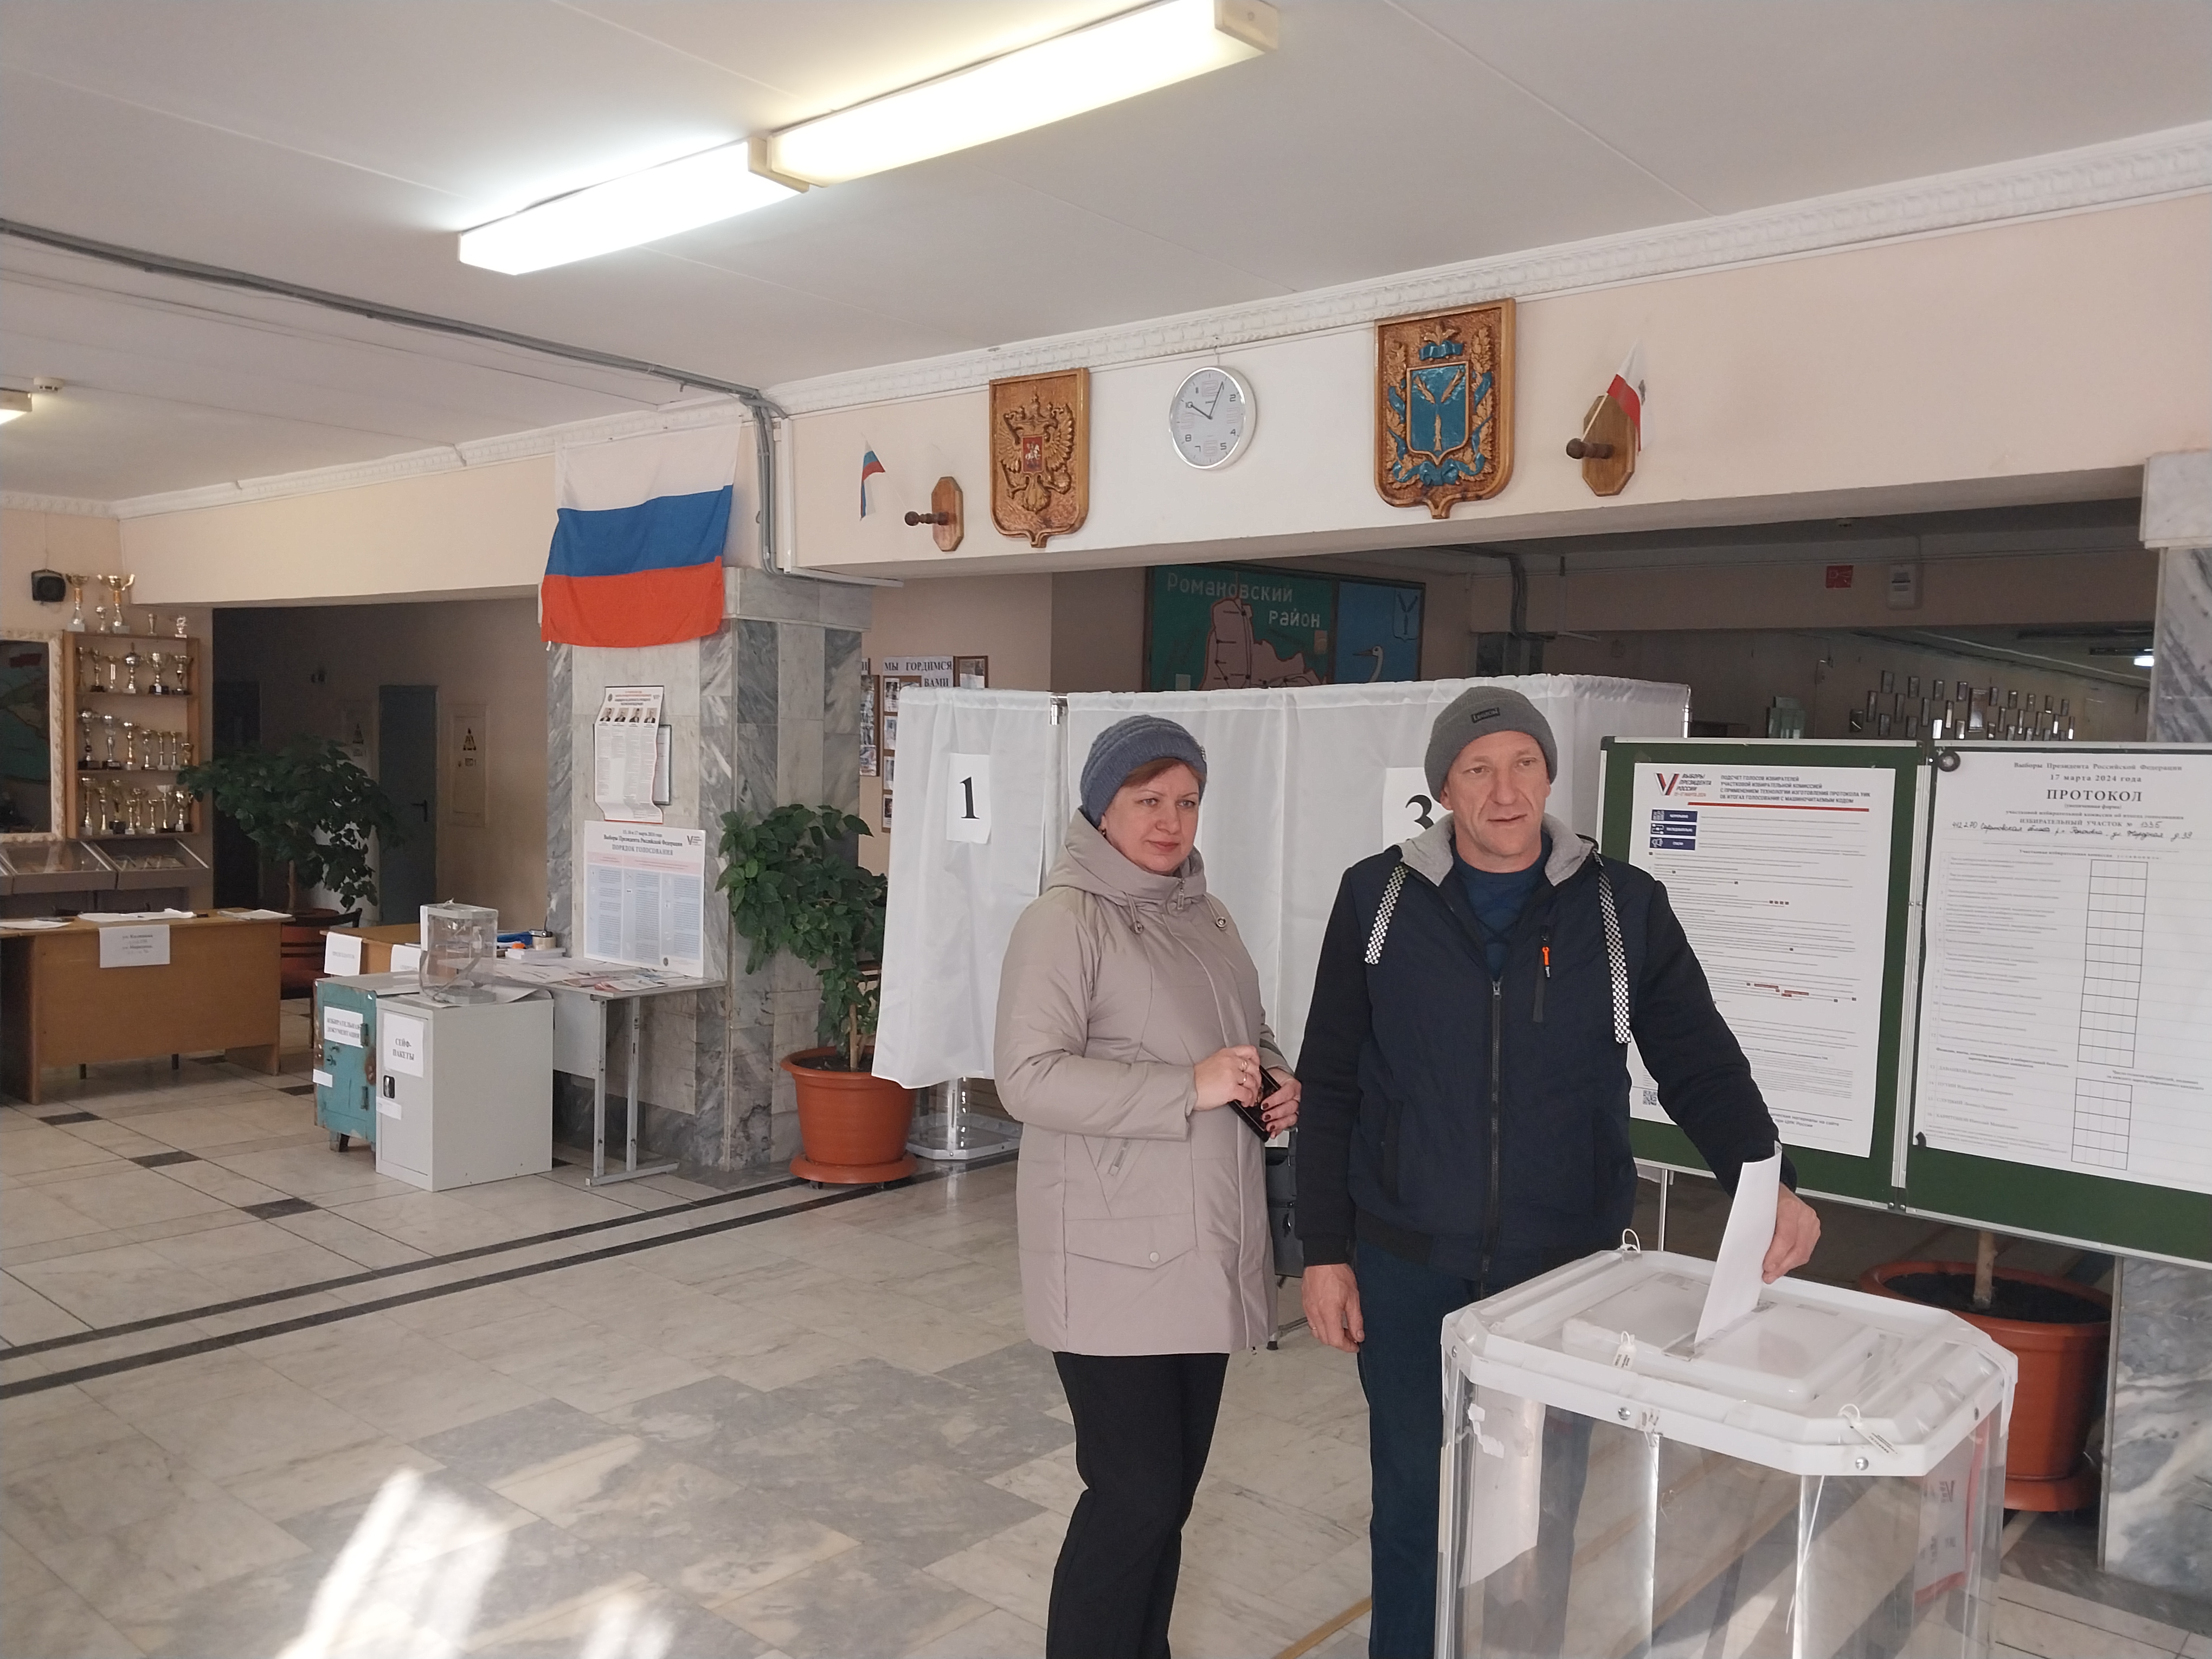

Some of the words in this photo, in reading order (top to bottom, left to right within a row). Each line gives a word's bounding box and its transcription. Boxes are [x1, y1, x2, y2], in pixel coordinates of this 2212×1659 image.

[1167, 573, 1293, 602] Романовский
[884, 662, 898, 671] МЫ
[906, 661, 952, 671] ГОРДИМСЯ
[924, 678, 949, 687] ВАМИ
[960, 776, 980, 819] 1
[2046, 789, 2142, 802] ПРОТОКОЛ
[395, 1038, 411, 1047] СЕЙФ-
[393, 1049, 414, 1060] ПАКЕТЫ
